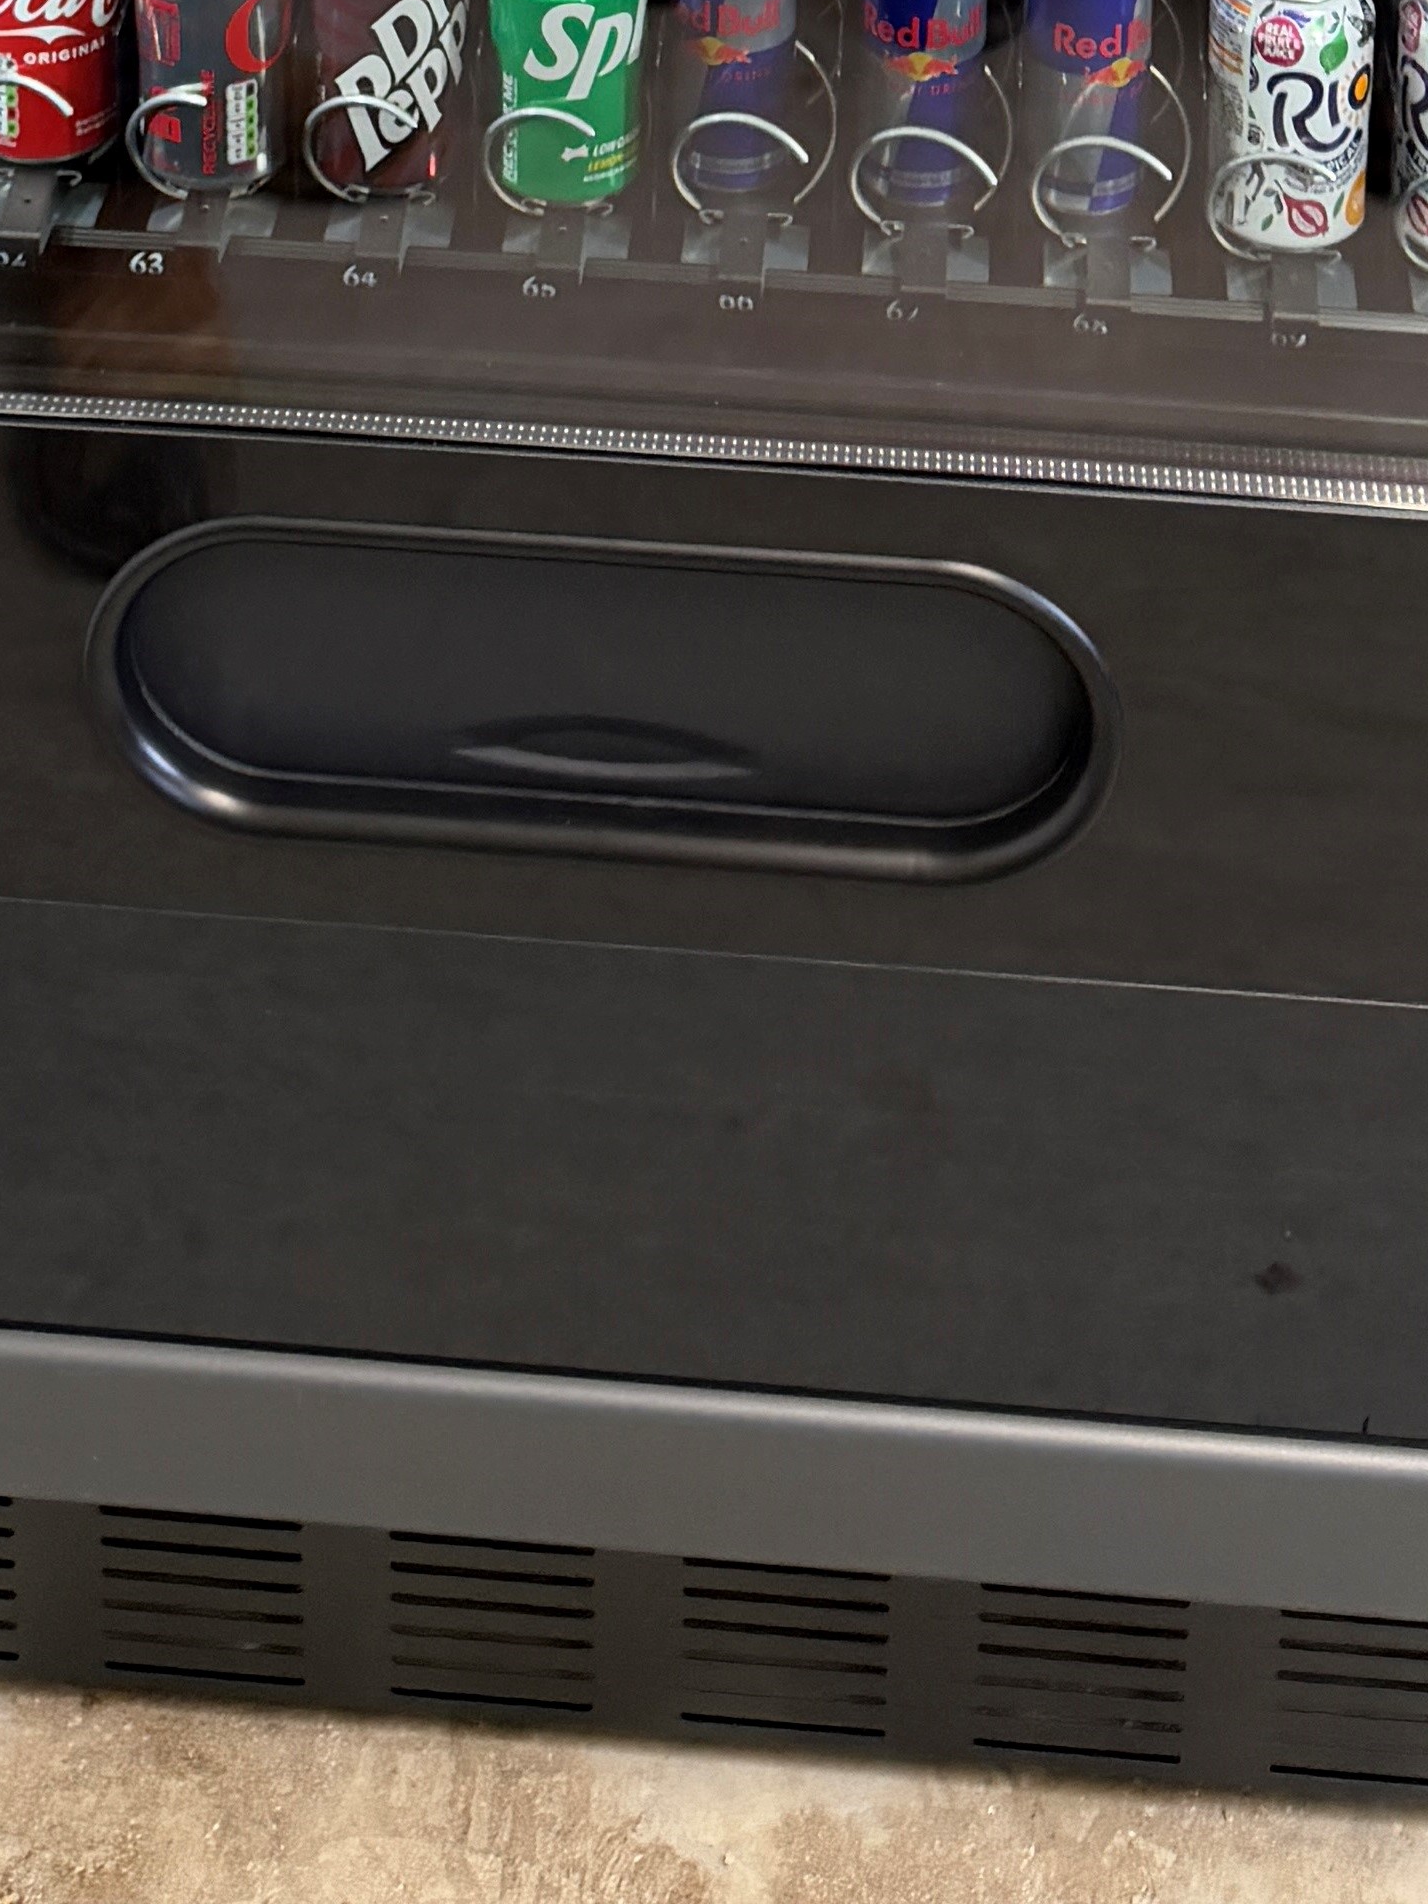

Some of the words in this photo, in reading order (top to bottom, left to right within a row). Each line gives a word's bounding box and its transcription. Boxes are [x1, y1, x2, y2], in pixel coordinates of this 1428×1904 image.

[862, 1, 921, 50] Red
[925, 3, 984, 51] Bull
[1052, 20, 1124, 60] Red
[129, 251, 165, 276] 63
